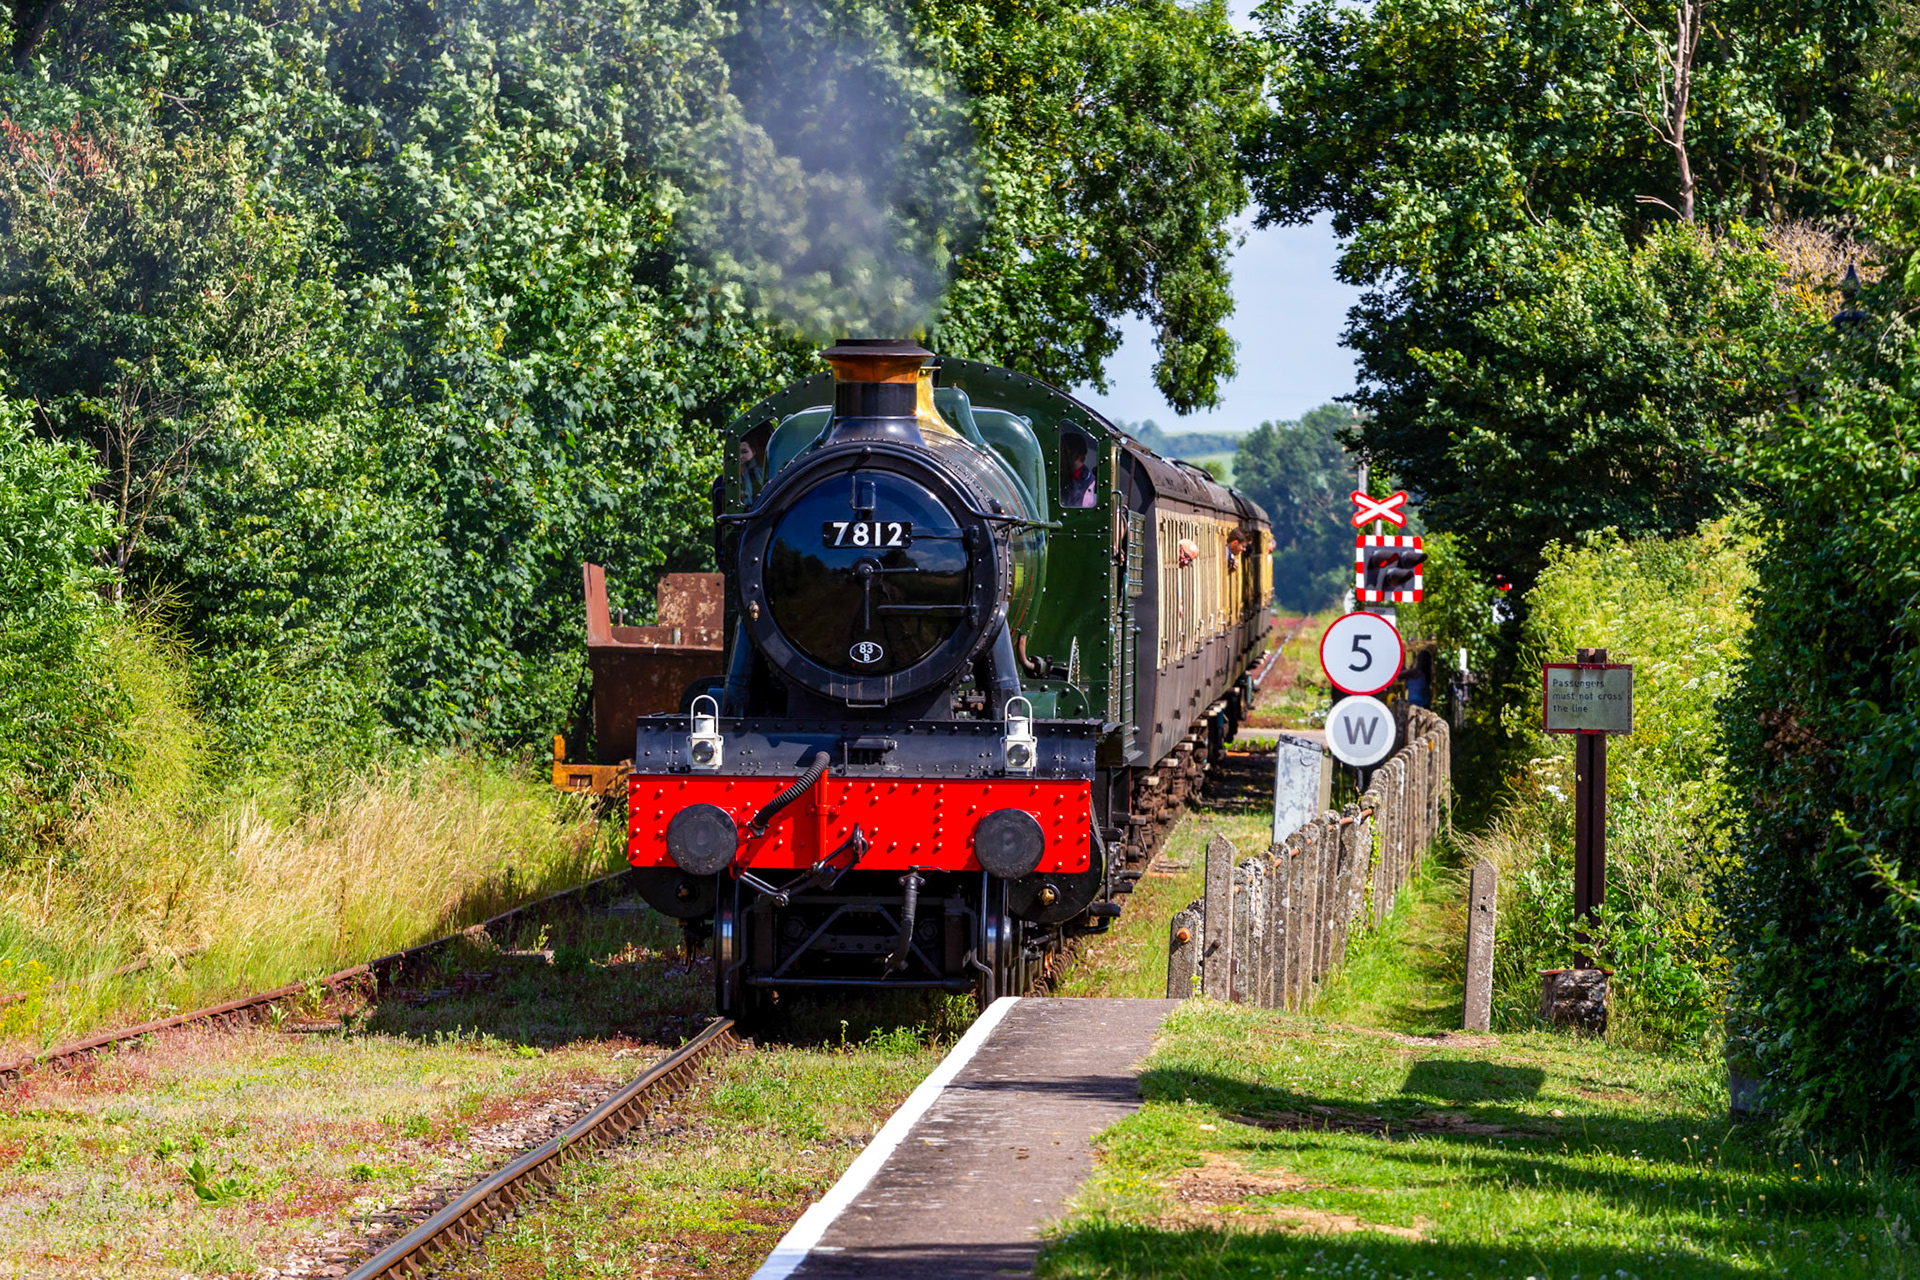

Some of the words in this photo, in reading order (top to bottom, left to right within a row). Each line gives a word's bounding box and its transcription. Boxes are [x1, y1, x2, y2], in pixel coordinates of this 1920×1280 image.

[833, 522, 902, 546] 7812
[859, 644, 874, 654] 83
[1348, 634, 1373, 672] 5
[863, 653, 870, 662] B
[1552, 678, 1605, 688] Passengers
[1553, 704, 1568, 712] the
[1572, 704, 1588, 712] line
[1343, 716, 1379, 745] W
